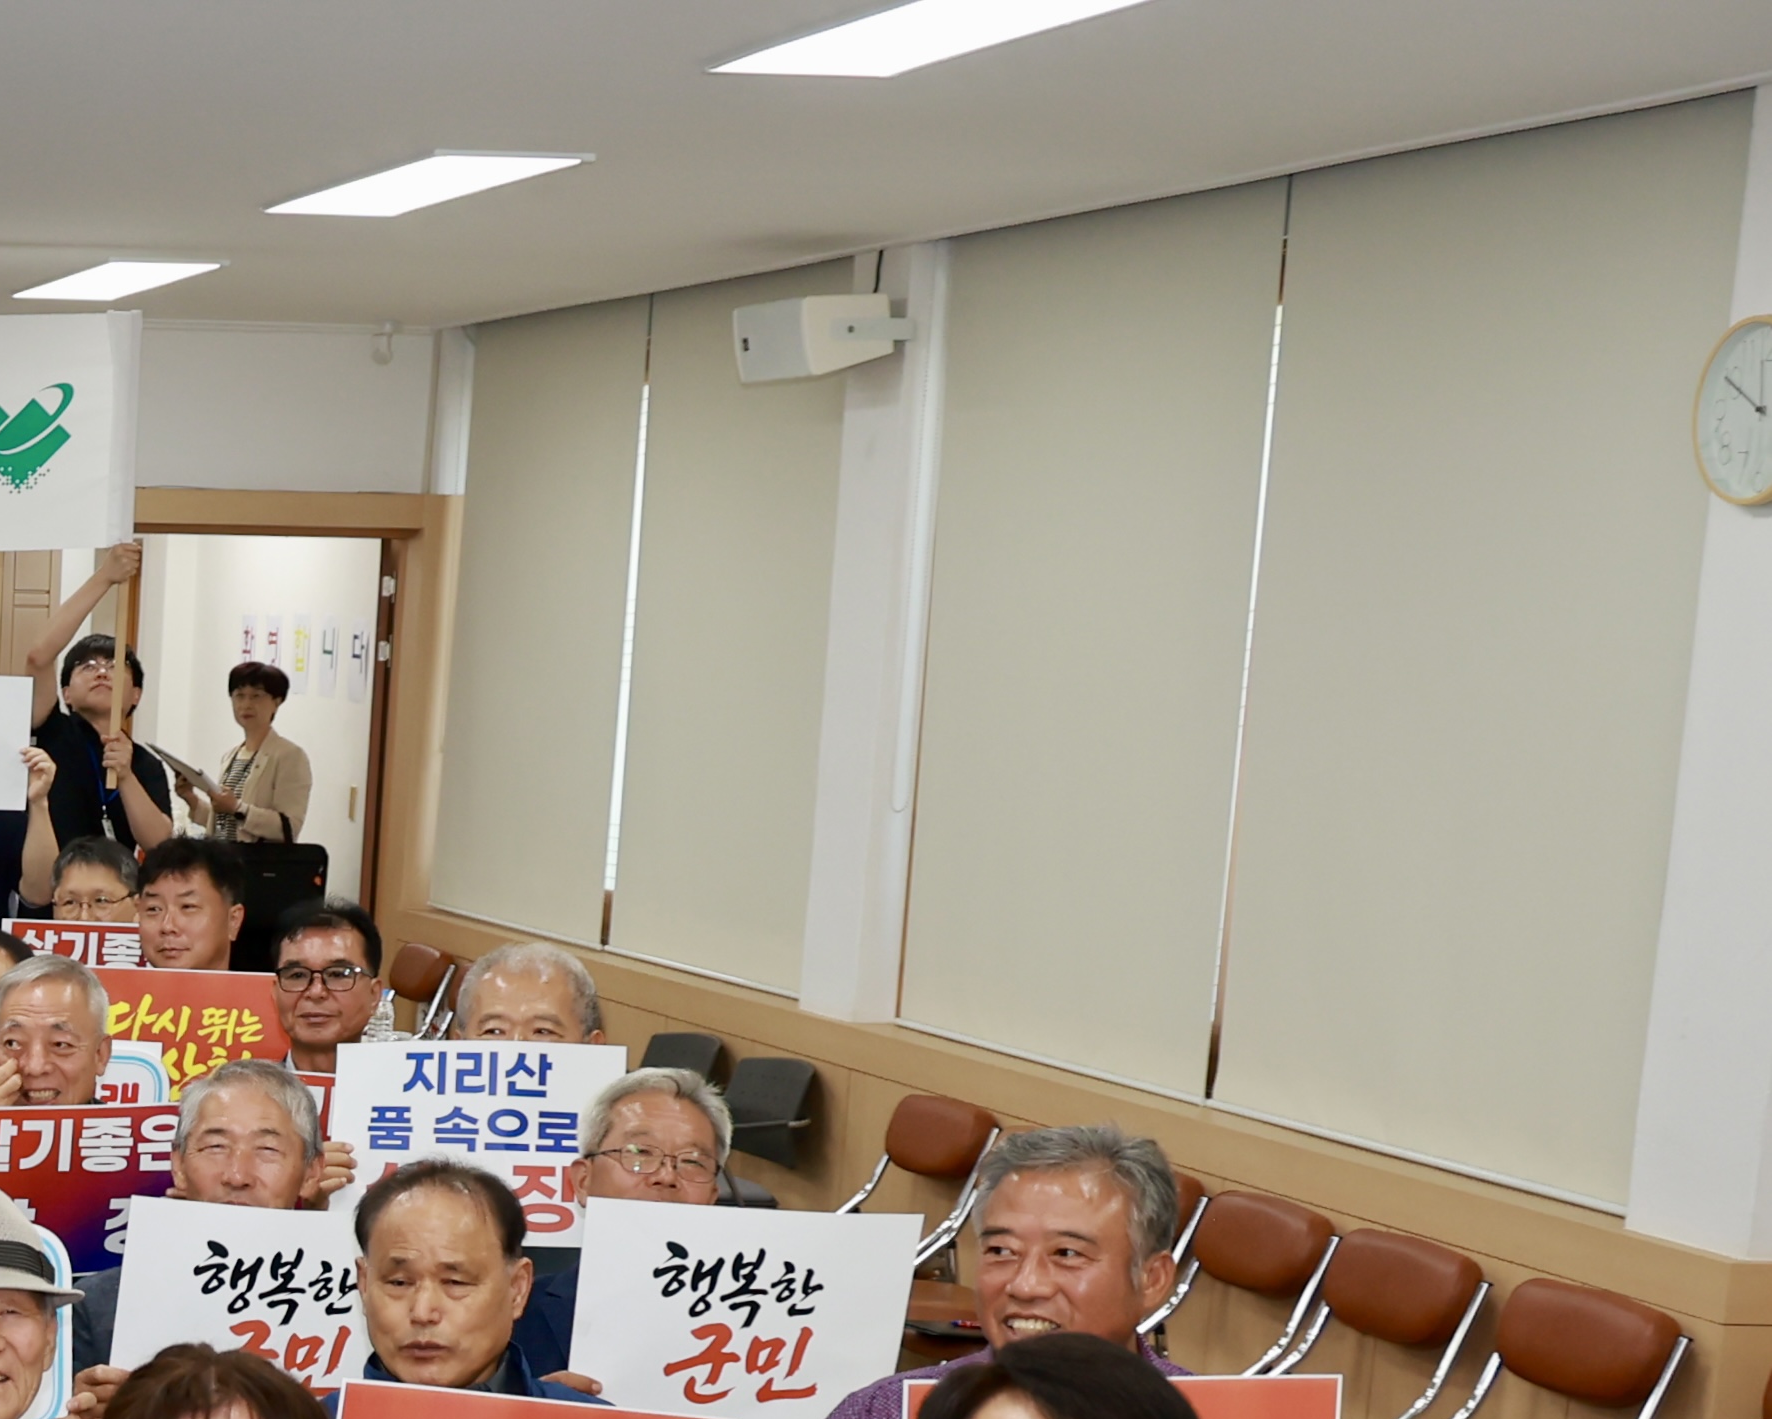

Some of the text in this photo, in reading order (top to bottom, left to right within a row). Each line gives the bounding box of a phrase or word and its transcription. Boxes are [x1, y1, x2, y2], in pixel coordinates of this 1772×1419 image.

[22, 926, 147, 967] 살기좋
[107, 994, 264, 1047] 다시 뛰는
[403, 1051, 552, 1098] 지리산
[367, 1106, 413, 1150] 품
[434, 1106, 579, 1153] 속으로
[193, 1240, 358, 1327] 행복한
[653, 1240, 824, 1329] 행복한
[663, 1322, 818, 1405] 군민
